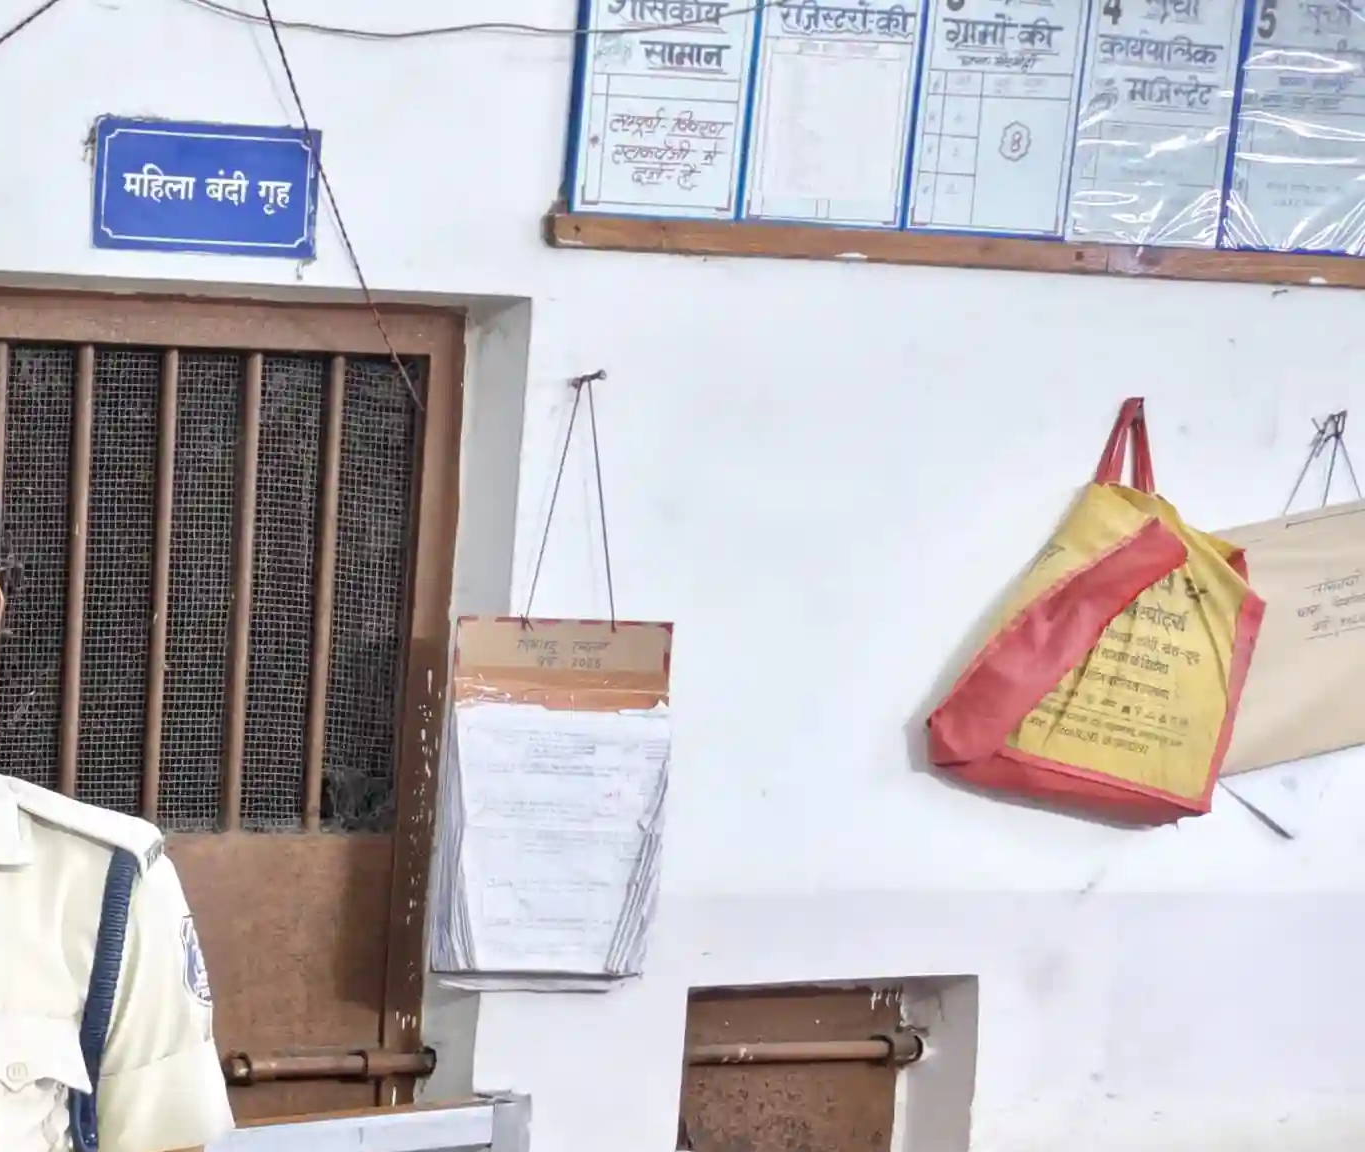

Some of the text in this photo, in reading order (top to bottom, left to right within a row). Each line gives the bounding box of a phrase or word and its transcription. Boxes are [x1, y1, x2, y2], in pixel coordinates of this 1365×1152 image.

[1257, 0, 1277, 39] 5
[639, 40, 732, 67] सामान
[123, 163, 293, 215] महिला बंदी गृह
